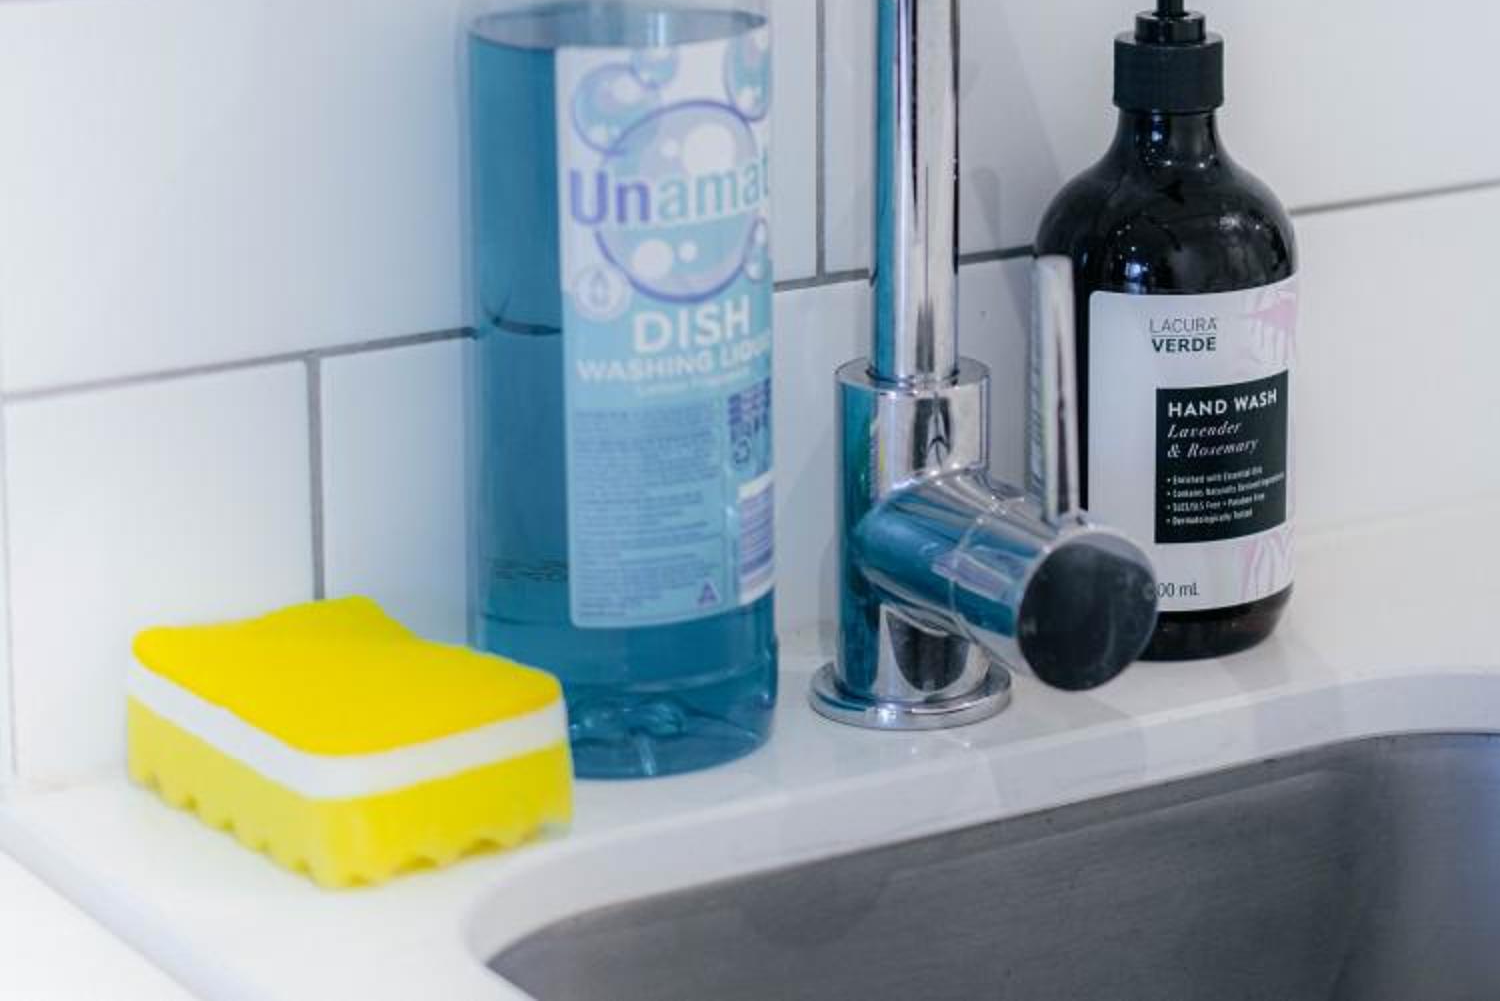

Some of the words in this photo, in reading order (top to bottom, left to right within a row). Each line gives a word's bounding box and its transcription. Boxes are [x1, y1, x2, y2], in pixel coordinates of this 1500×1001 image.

[633, 296, 749, 353] DISH
[1150, 317, 1217, 333] LACURA
[1151, 337, 1217, 353] VERDE
[575, 350, 714, 383] WASHING
[1167, 399, 1228, 418] HAND
[1234, 388, 1278, 412] WASH
[1167, 421, 1242, 438] Lavender
[1167, 445, 1181, 459] &
[1187, 439, 1259, 458] Rosemary
[1172, 489, 1204, 498] Contains
[1156, 582, 1176, 597] 00
